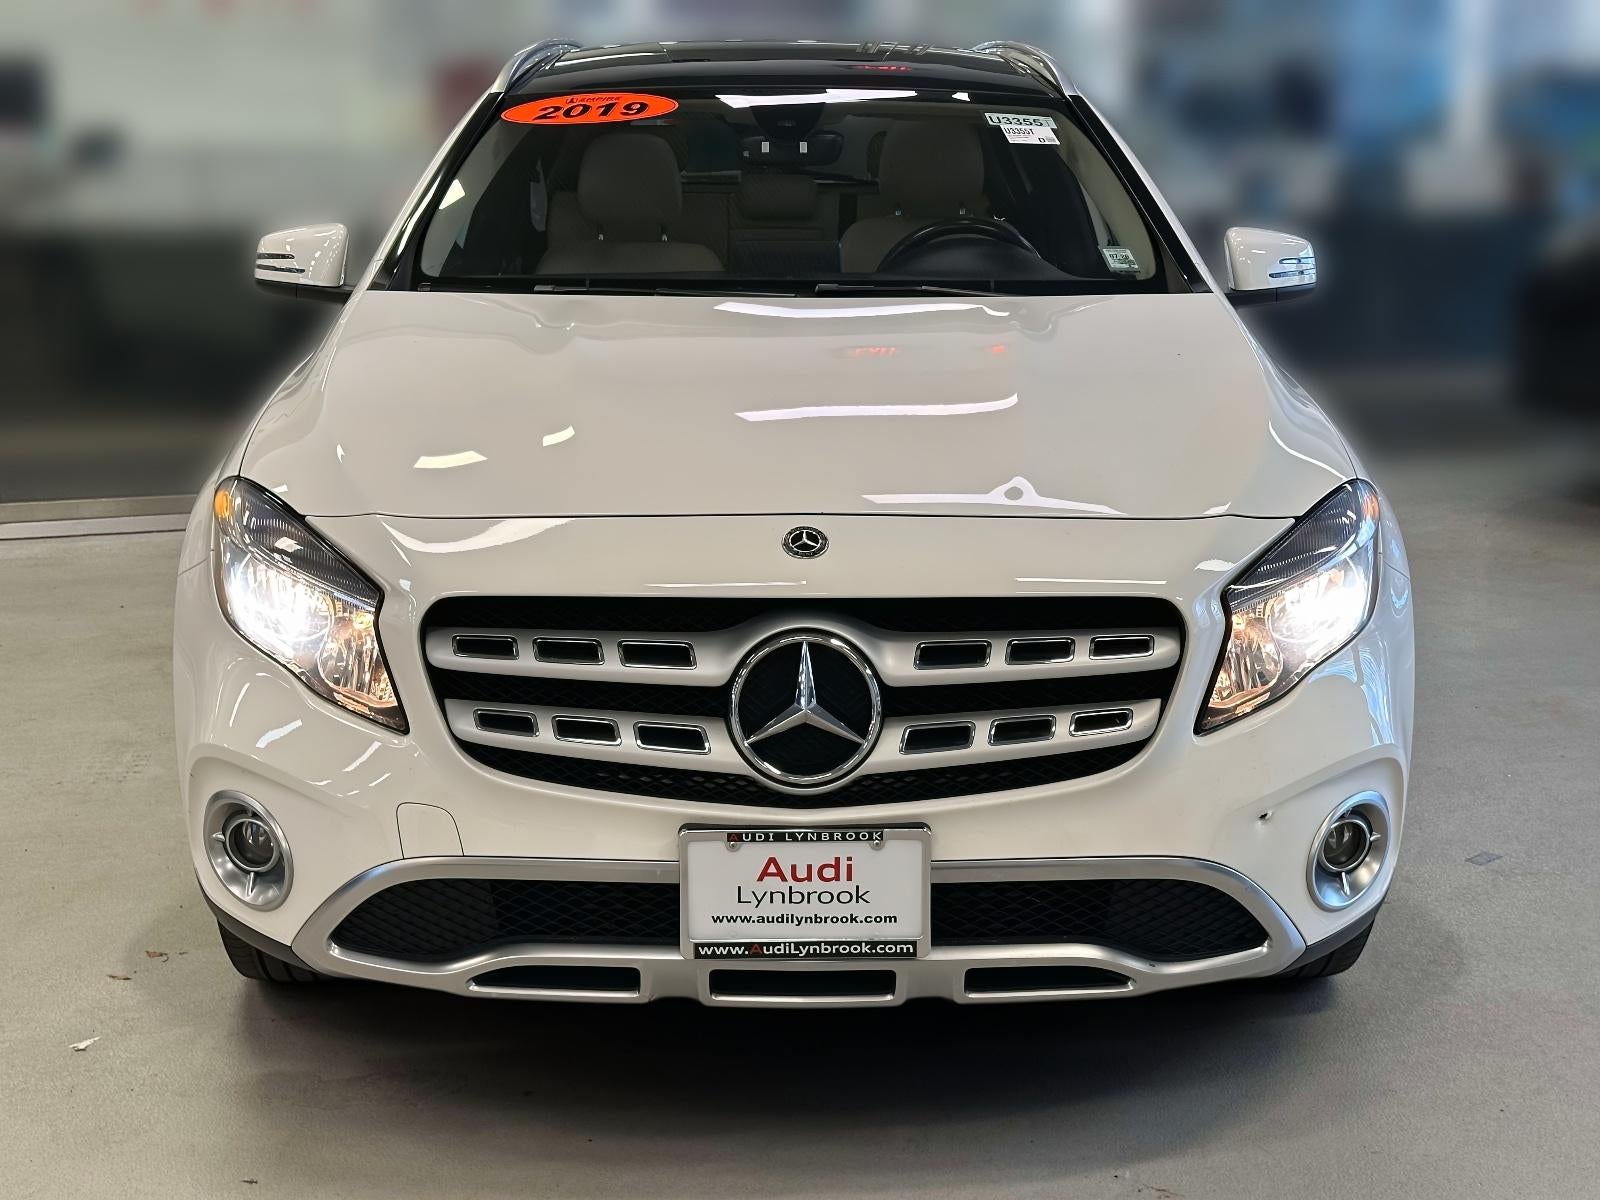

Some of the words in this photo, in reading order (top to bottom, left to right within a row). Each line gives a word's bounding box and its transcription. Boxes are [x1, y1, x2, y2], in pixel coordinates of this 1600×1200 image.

[532, 101, 649, 121] 2019
[729, 832, 774, 842] AUDI
[785, 831, 882, 842] LYNBROOK
[756, 856, 853, 882] Audi
[737, 885, 870, 908] Lynbrook
[711, 913, 898, 926] www.audilynbrook.com
[698, 942, 914, 956] www.AudiLynbrook.com
